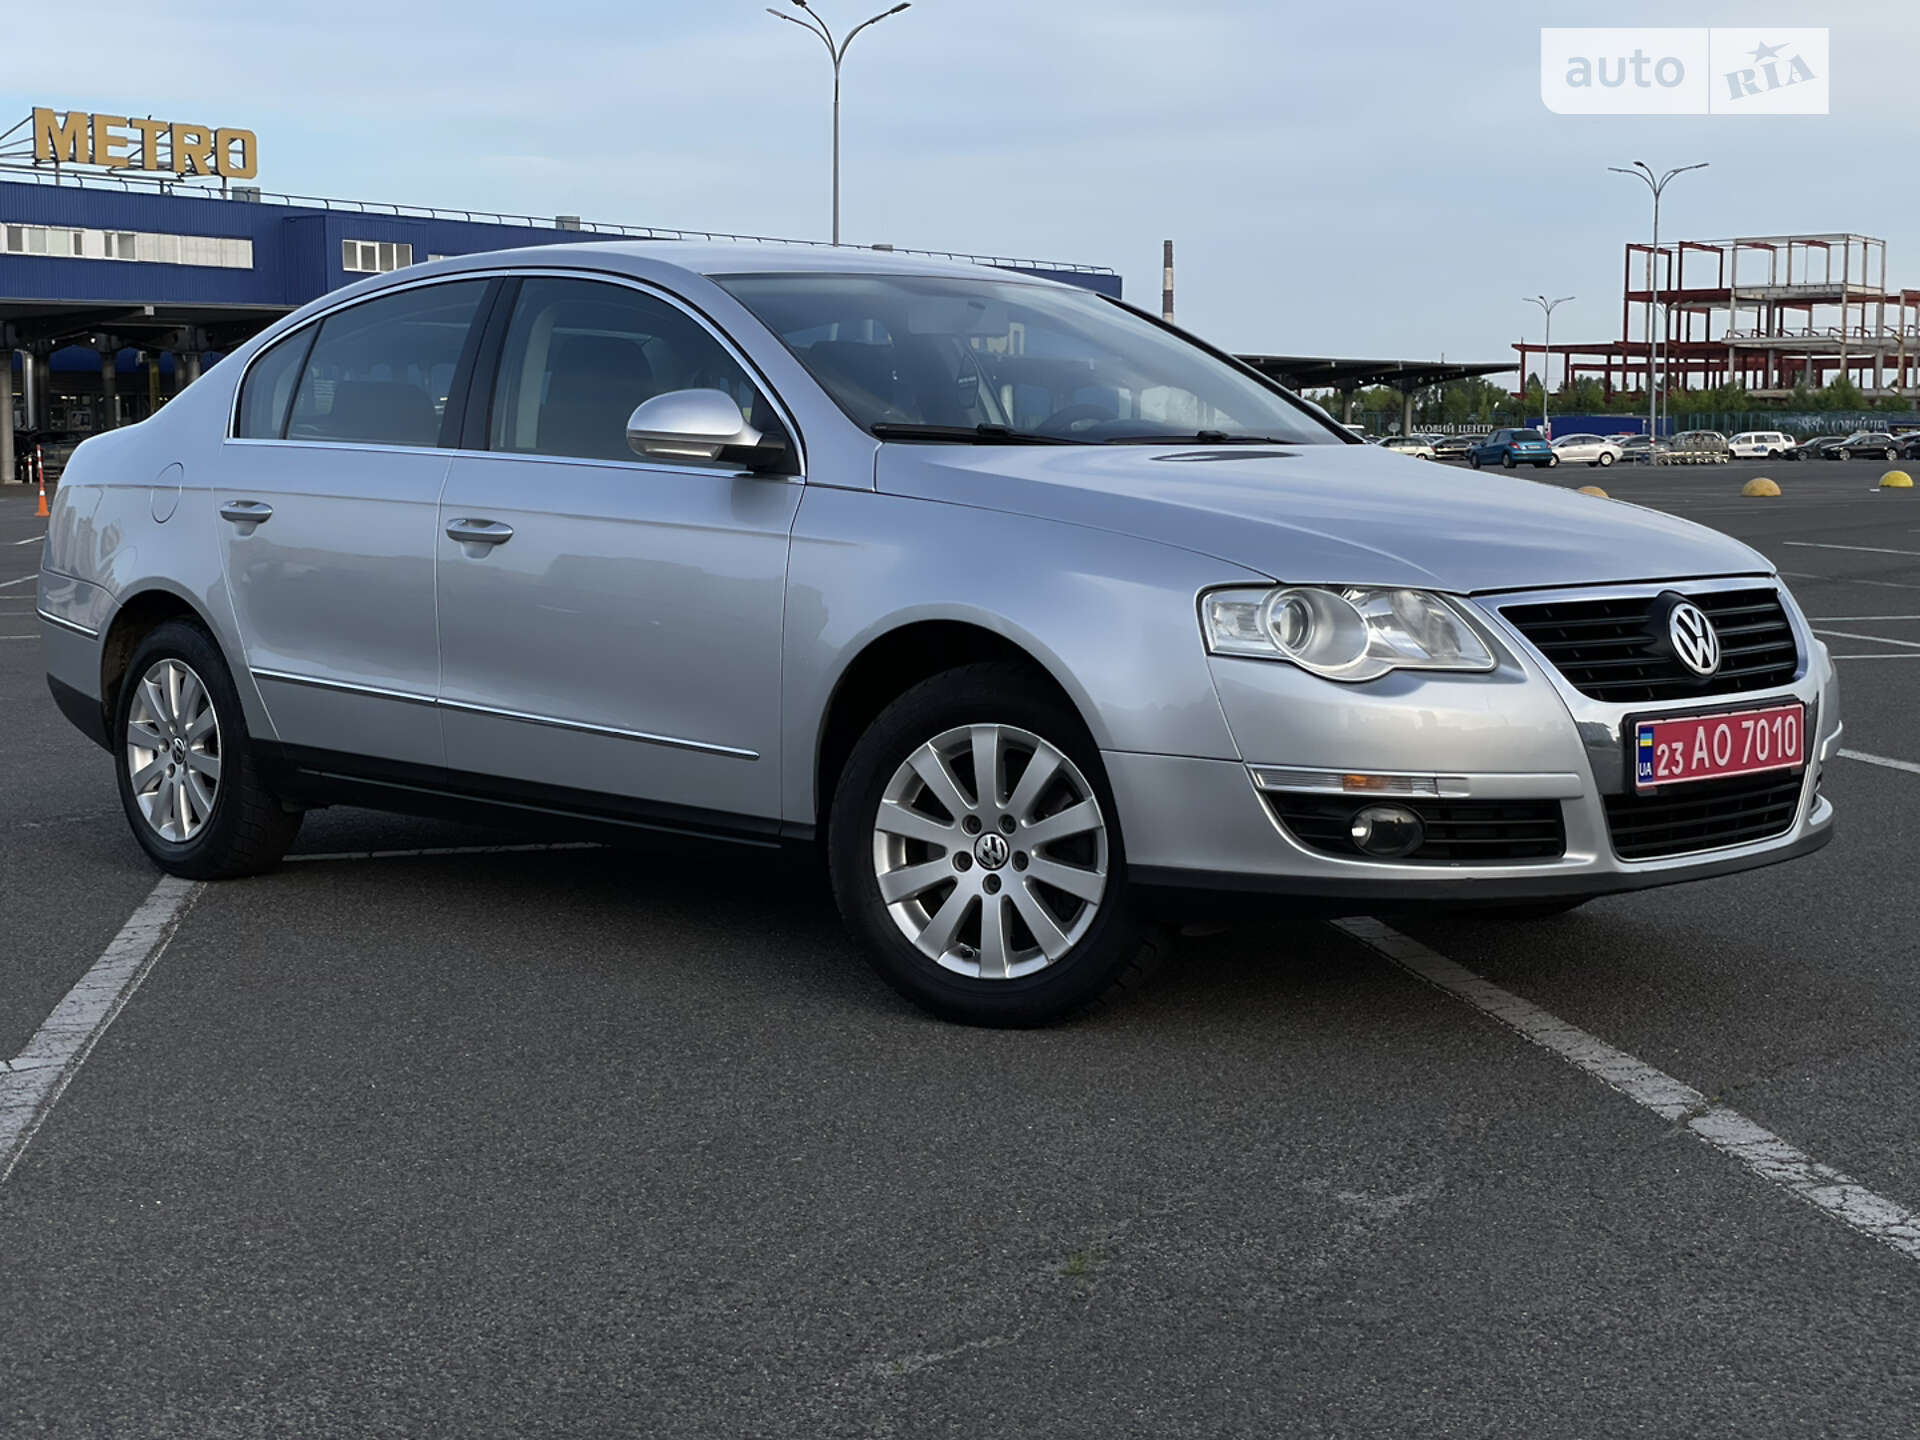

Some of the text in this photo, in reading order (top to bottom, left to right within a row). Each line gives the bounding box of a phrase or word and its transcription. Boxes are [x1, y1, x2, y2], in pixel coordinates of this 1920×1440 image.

[32, 107, 258, 179] METRO
[1639, 762, 1652, 776] UA
[1657, 714, 1797, 777] 23 AO 7010
